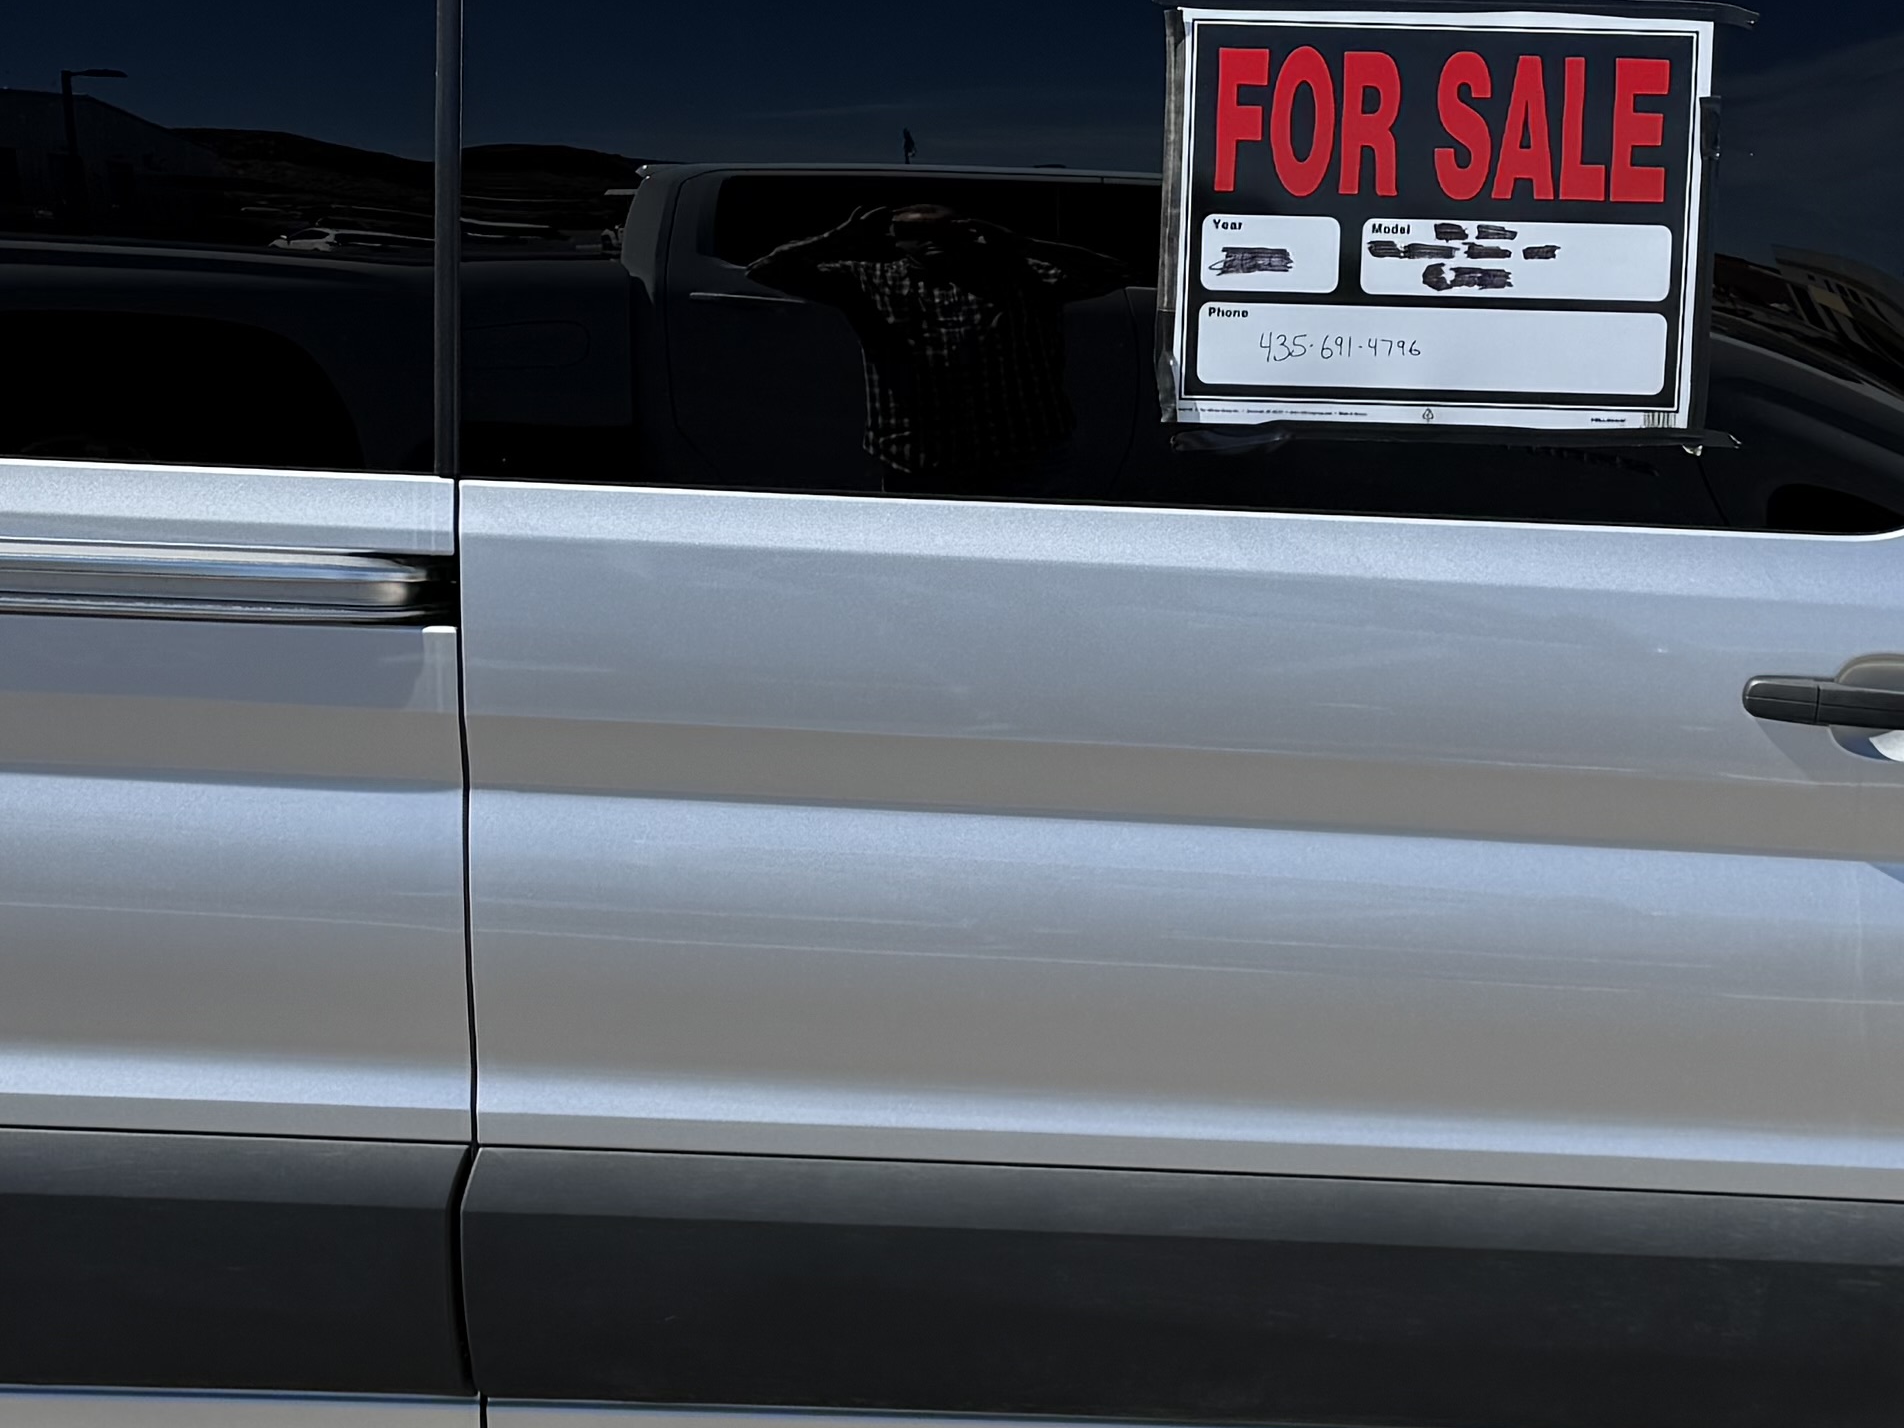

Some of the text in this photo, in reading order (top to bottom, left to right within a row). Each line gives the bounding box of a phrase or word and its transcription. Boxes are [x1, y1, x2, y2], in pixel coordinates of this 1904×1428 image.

[1213, 45, 1671, 203] FOR SALE
[1212, 218, 1243, 231] Year
[1371, 223, 1411, 235] Model
[1207, 306, 1249, 318] Phone
